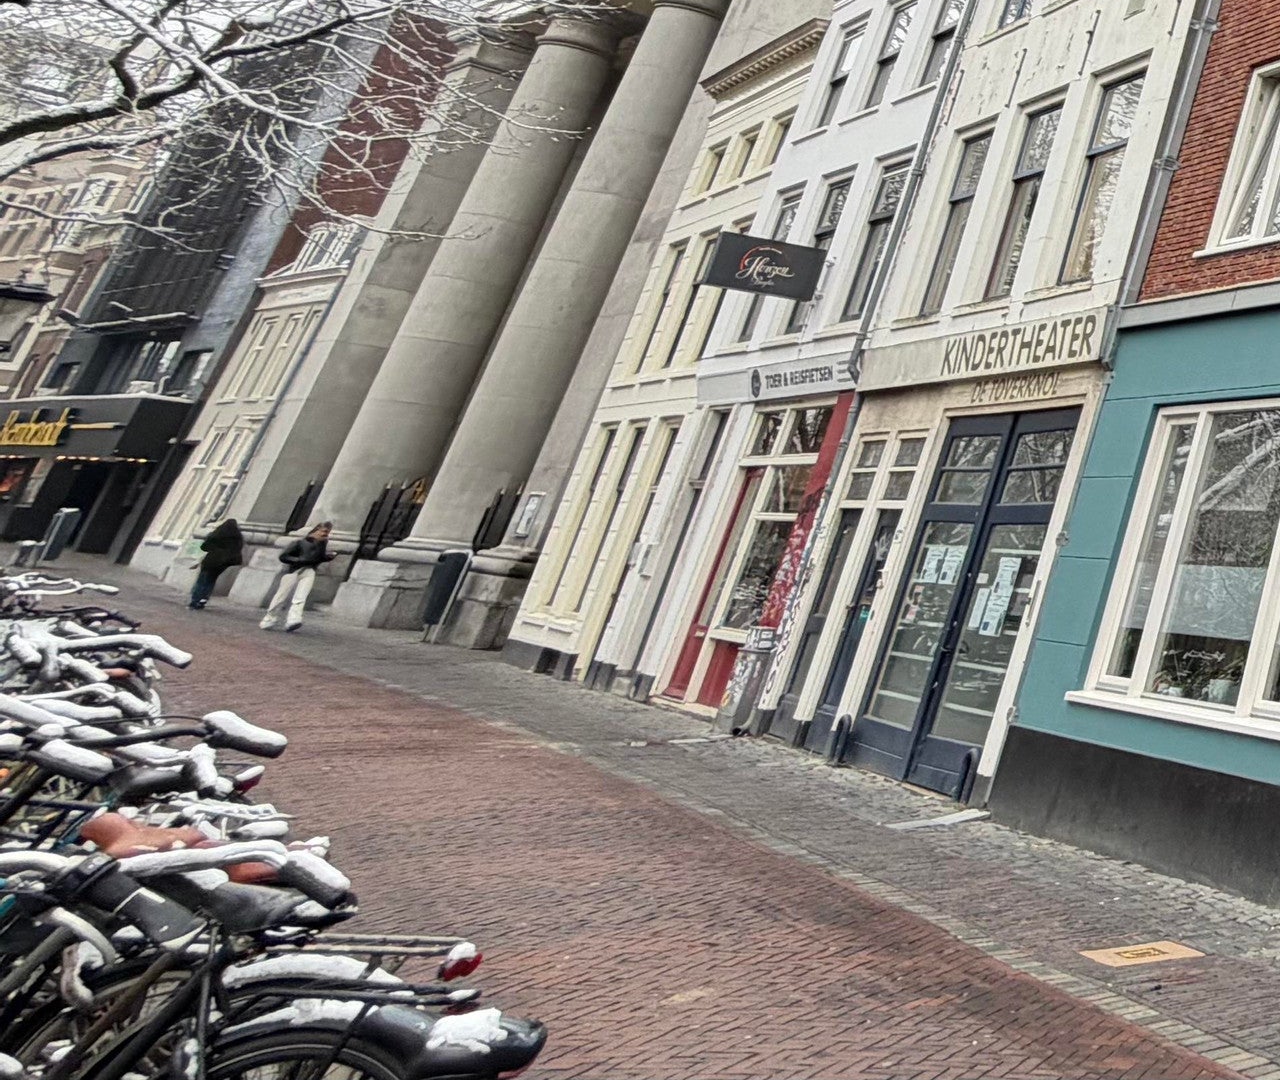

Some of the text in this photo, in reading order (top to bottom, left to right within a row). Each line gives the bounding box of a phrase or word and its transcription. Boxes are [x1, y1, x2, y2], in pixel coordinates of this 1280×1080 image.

[940, 314, 1097, 376] KINDERTHEATER
[765, 373, 782, 390] TOER
[970, 371, 1061, 404] DE TOVERKNOL
